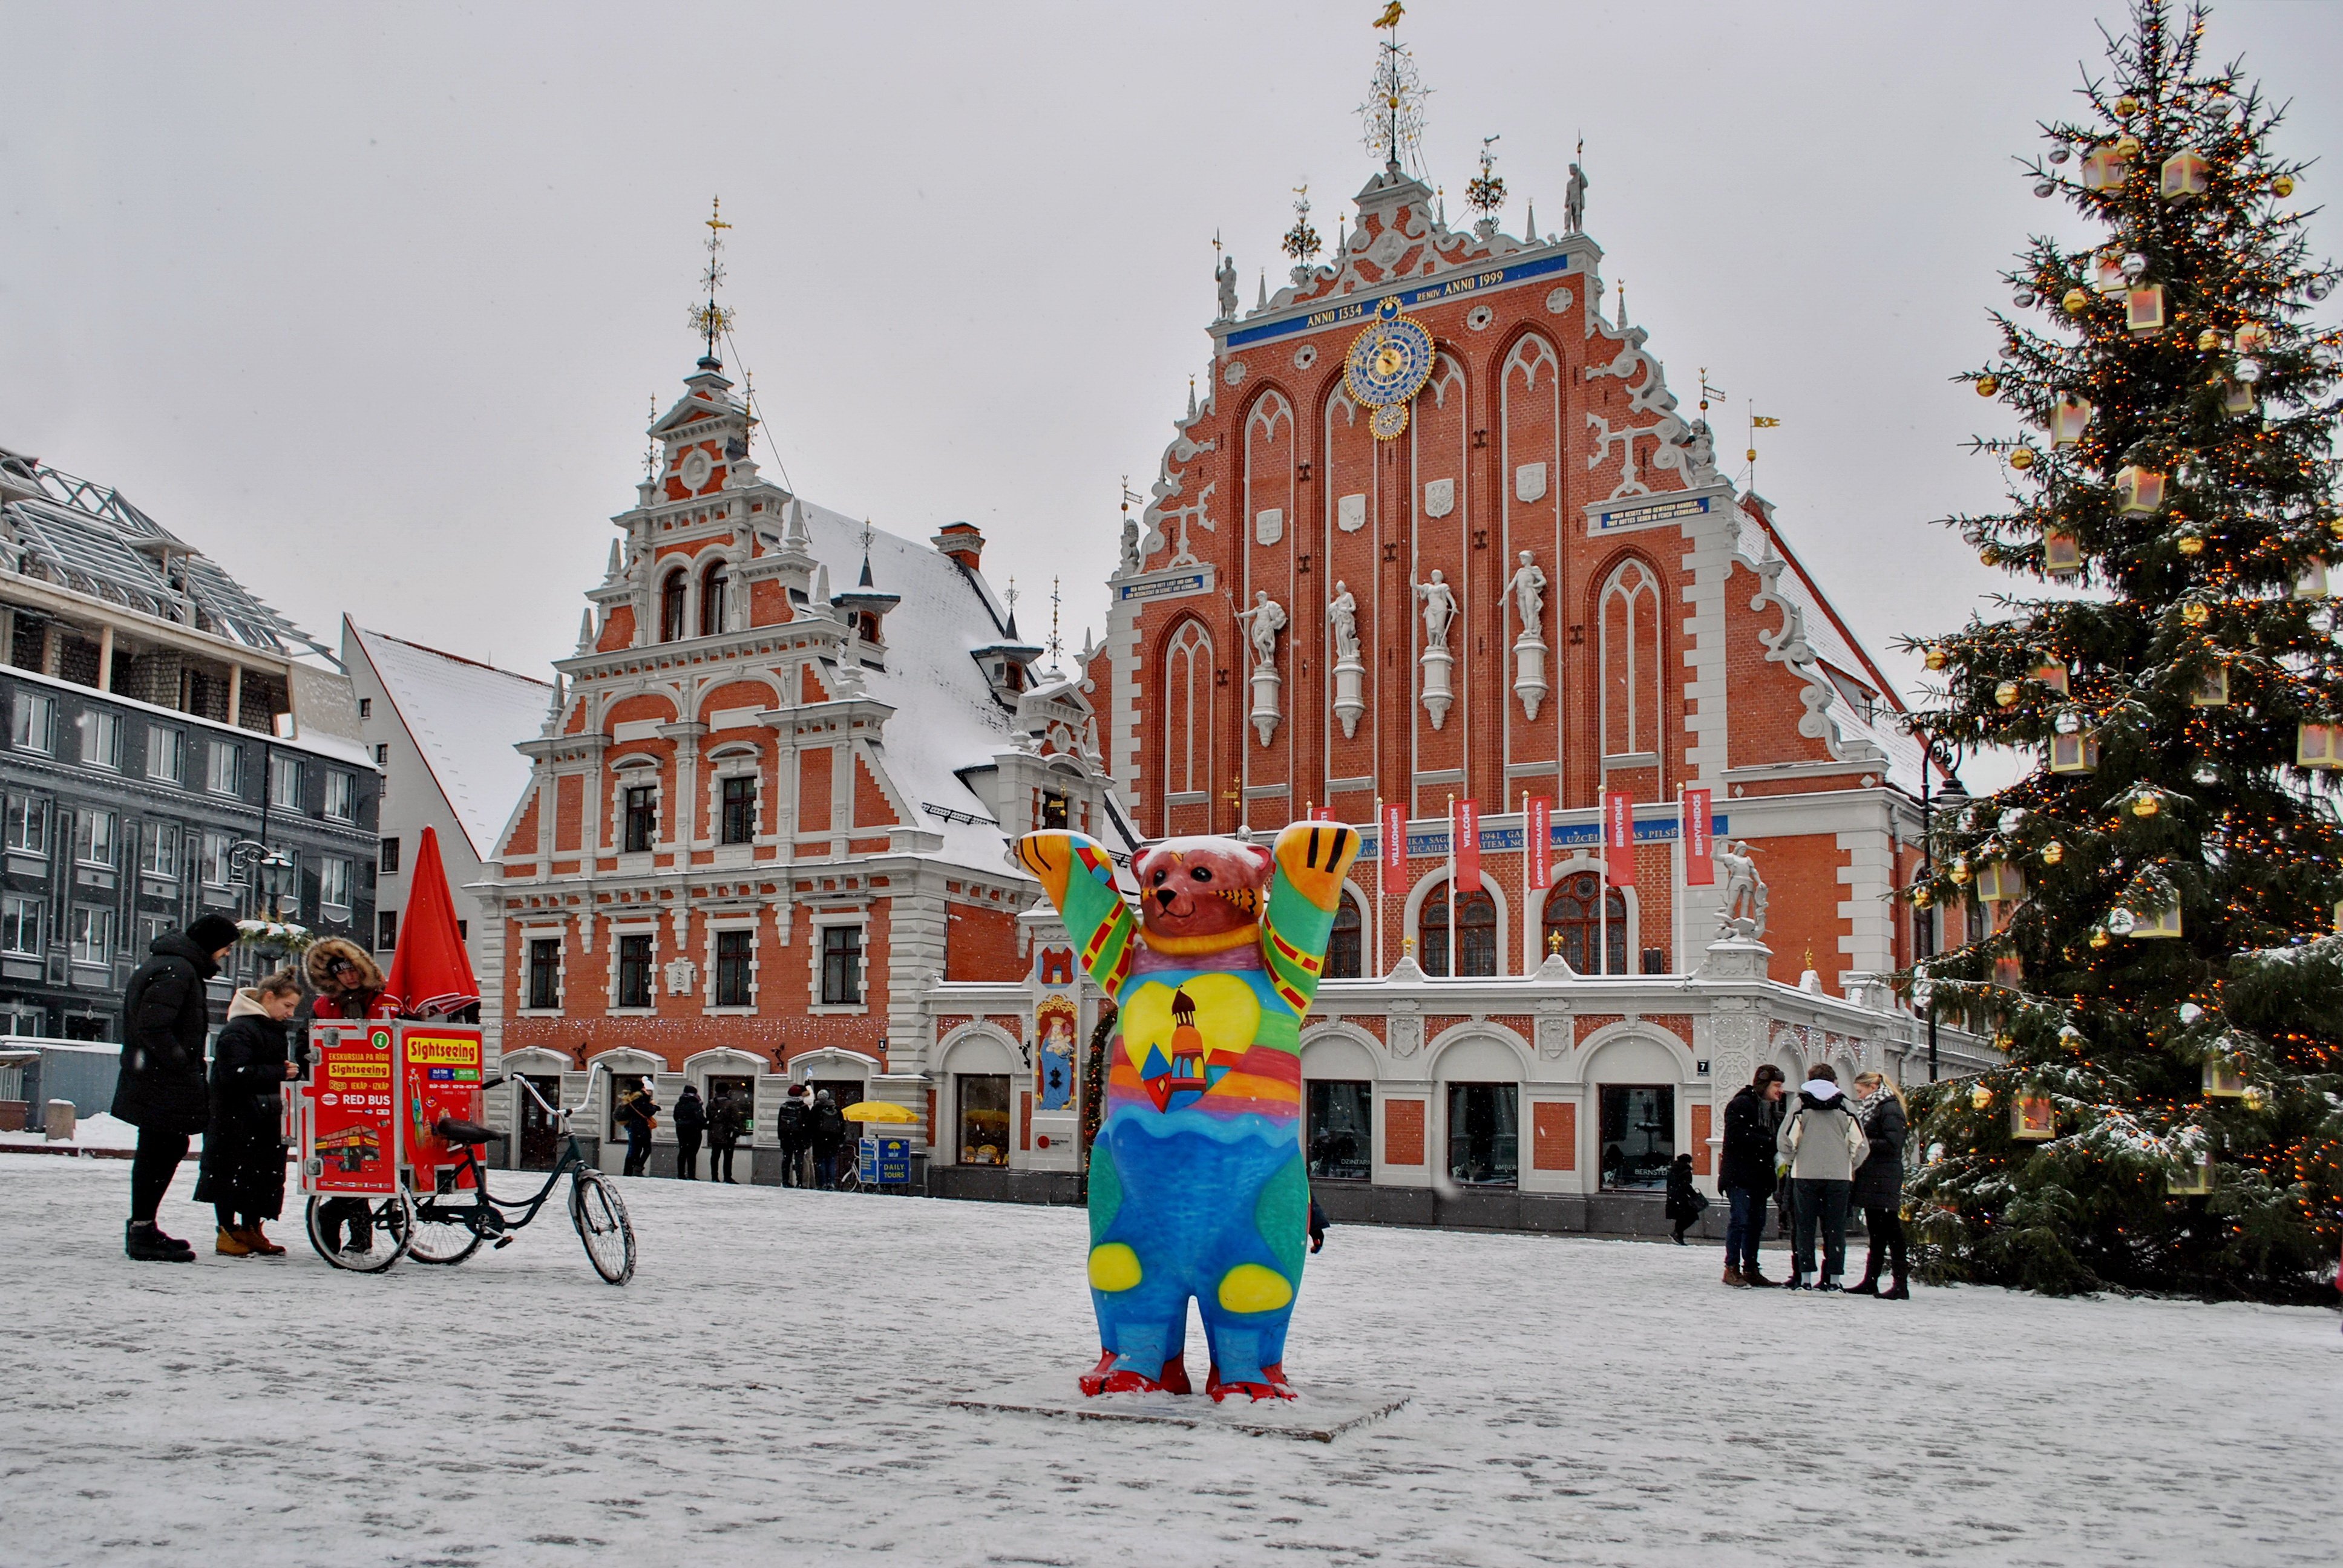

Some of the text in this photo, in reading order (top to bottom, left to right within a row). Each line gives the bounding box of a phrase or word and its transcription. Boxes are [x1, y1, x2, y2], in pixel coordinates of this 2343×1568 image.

[1444, 277, 1475, 295] ANNO
[1480, 270, 1504, 287] 1999
[1306, 304, 1362, 327] ANNO 1334
[1462, 804, 1470, 848] WELCOME
[1614, 797, 1624, 847] BIENVENUE
[1693, 794, 1703, 855] BIENVENIDOS
[1390, 808, 1399, 866] WILLKOMMEN
[375, 1052, 390, 1061] RĪGU
[411, 1041, 475, 1062] Sightseeing
[332, 1065, 387, 1076] Sightseeing
[342, 1094, 390, 1105] RED BUS
